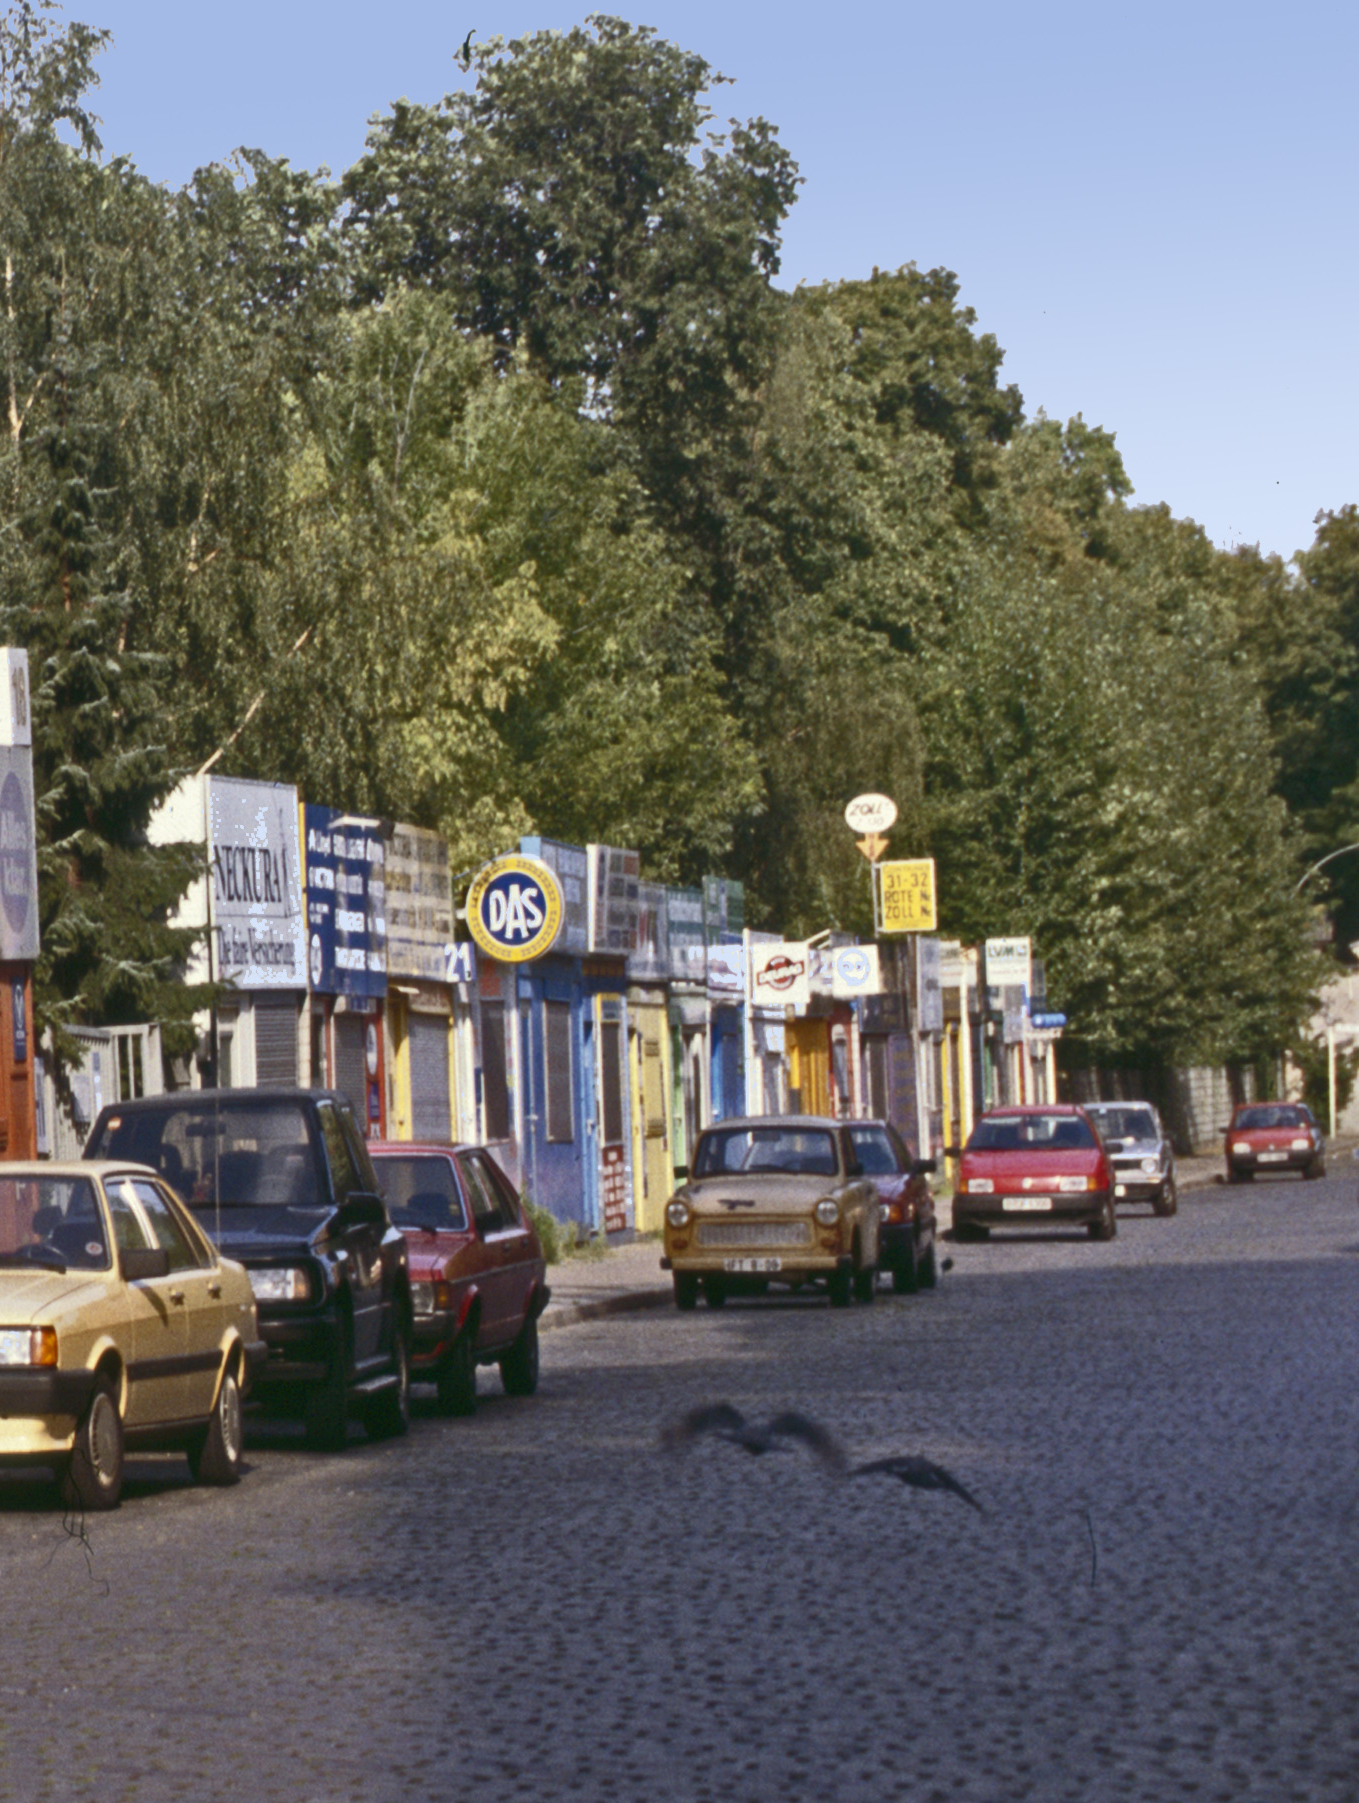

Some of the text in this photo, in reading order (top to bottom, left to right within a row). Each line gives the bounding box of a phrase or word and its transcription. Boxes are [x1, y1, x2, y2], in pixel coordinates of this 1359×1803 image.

[213, 844, 282, 902] NECKURA
[489, 884, 543, 939] DAS
[884, 889, 914, 904] ROTE
[885, 905, 914, 920] ZOLL
[444, 942, 473, 983] 21
